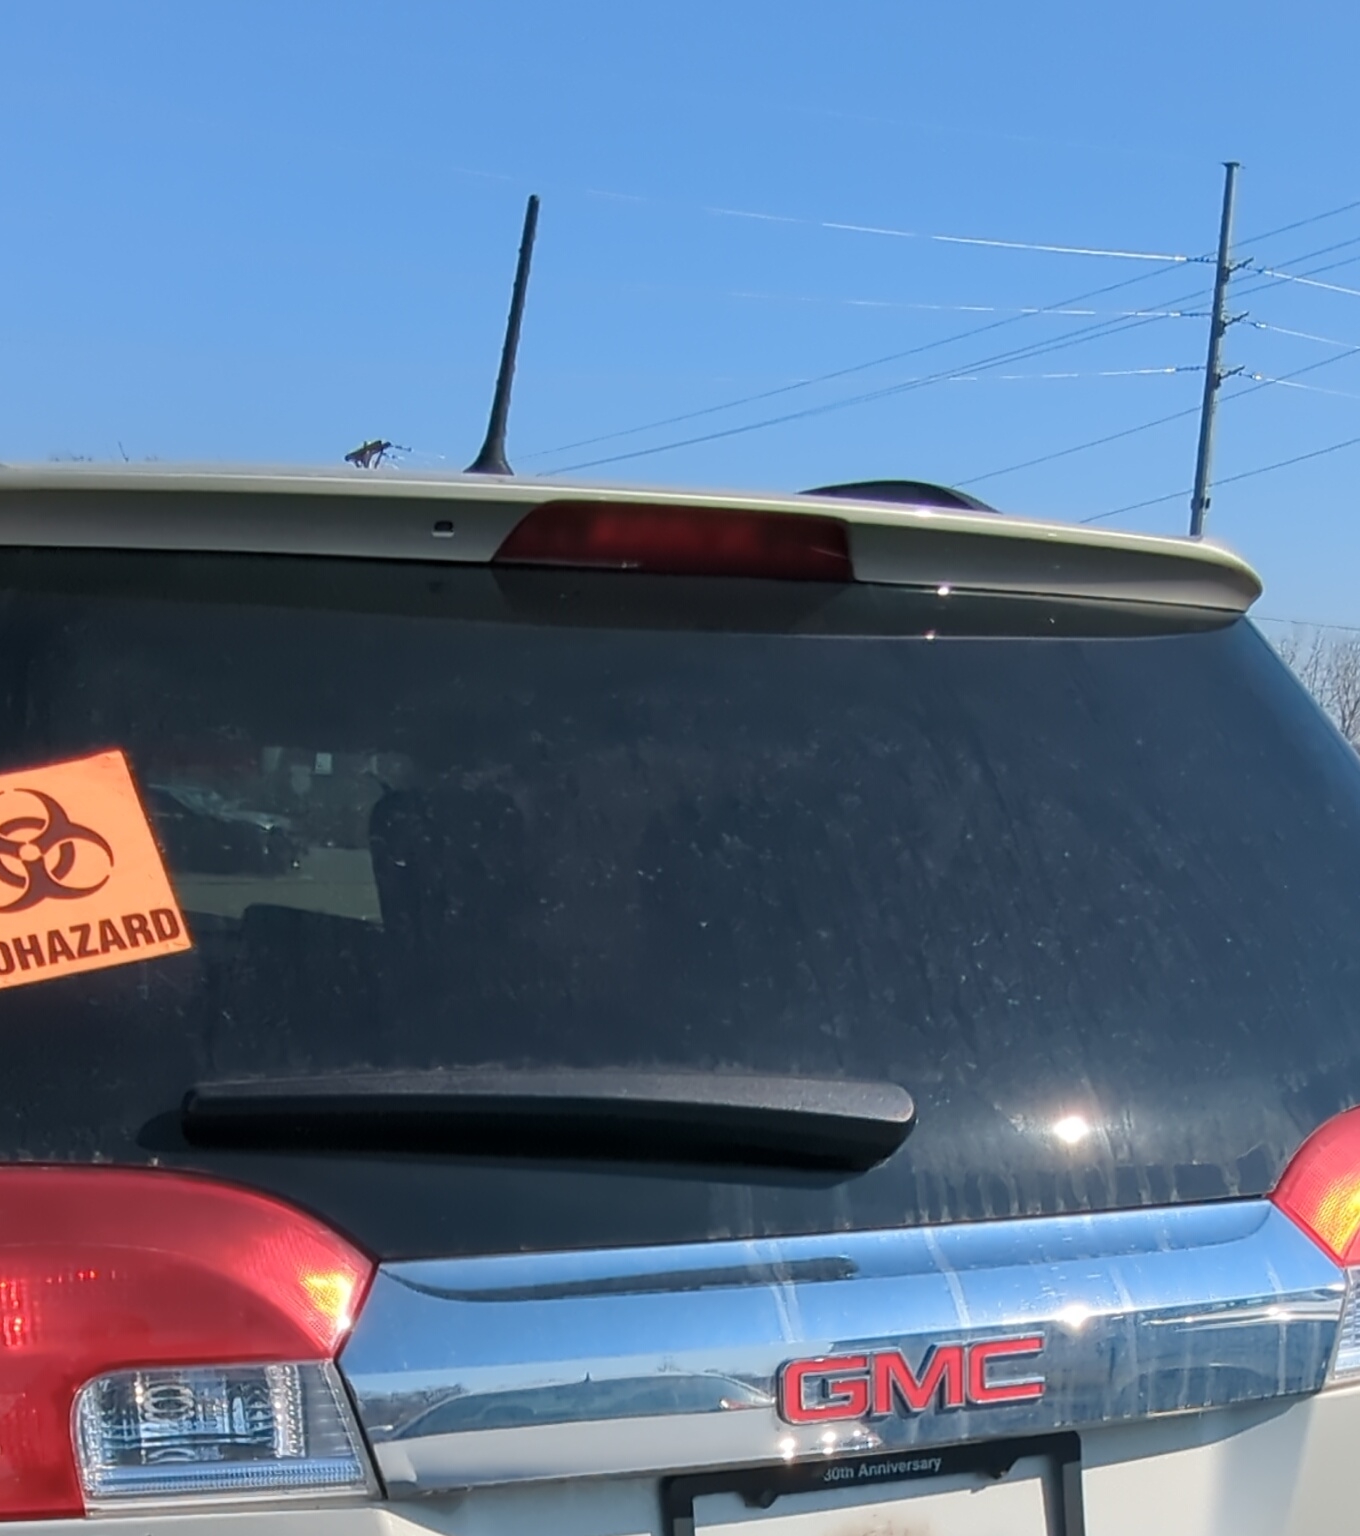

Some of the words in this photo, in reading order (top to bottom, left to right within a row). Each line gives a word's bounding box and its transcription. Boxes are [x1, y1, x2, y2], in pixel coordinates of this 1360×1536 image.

[778, 1332, 1045, 1425] GMC
[823, 1466, 855, 1482] 30th
[857, 1457, 942, 1478] Anniversary
